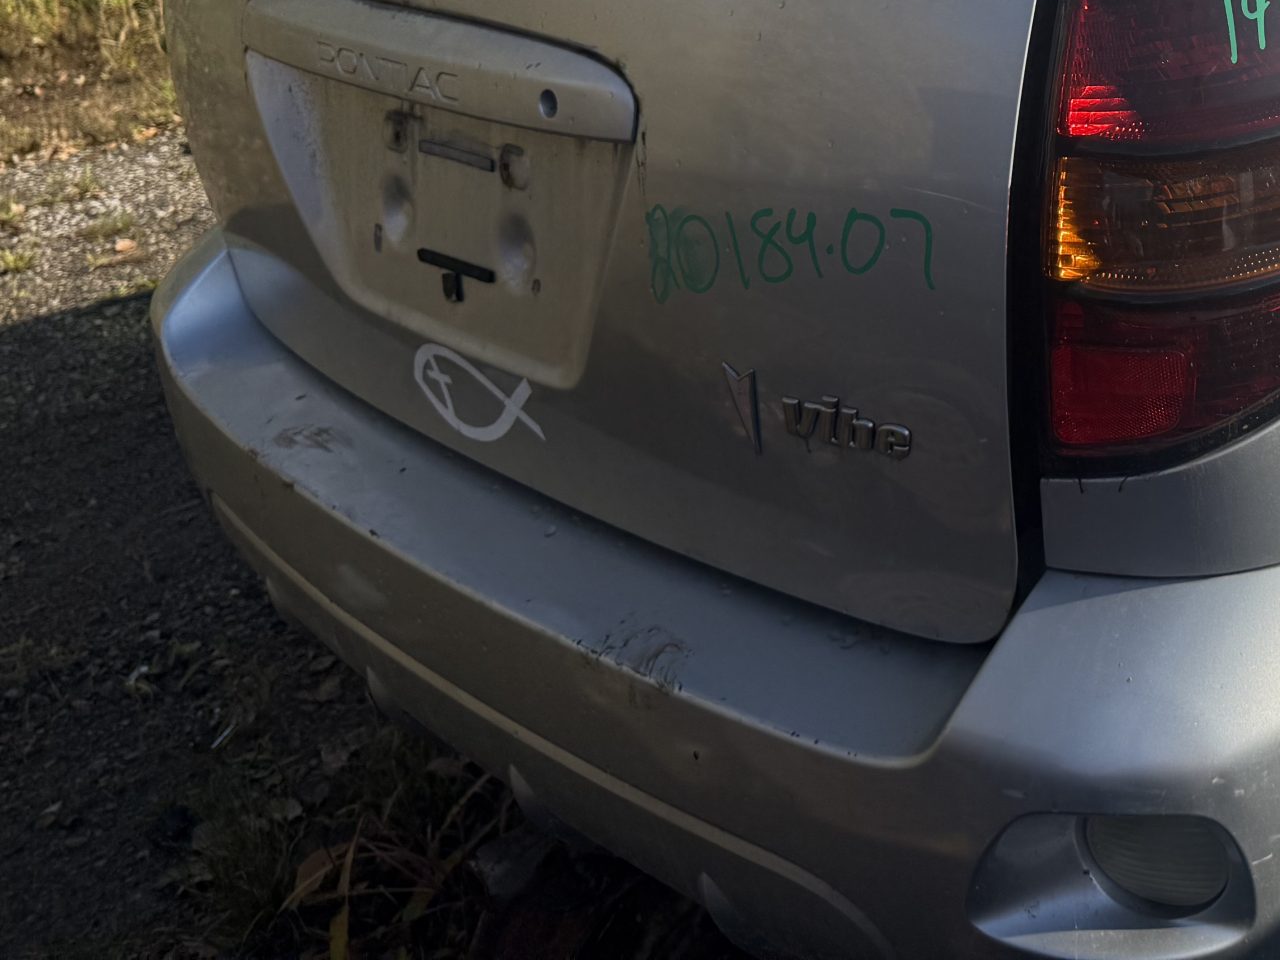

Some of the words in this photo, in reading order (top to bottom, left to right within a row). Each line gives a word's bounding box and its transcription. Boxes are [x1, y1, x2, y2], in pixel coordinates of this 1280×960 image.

[316, 40, 460, 103] PONTIAC
[645, 203, 937, 304] 20184.07
[781, 395, 914, 461] vibe
